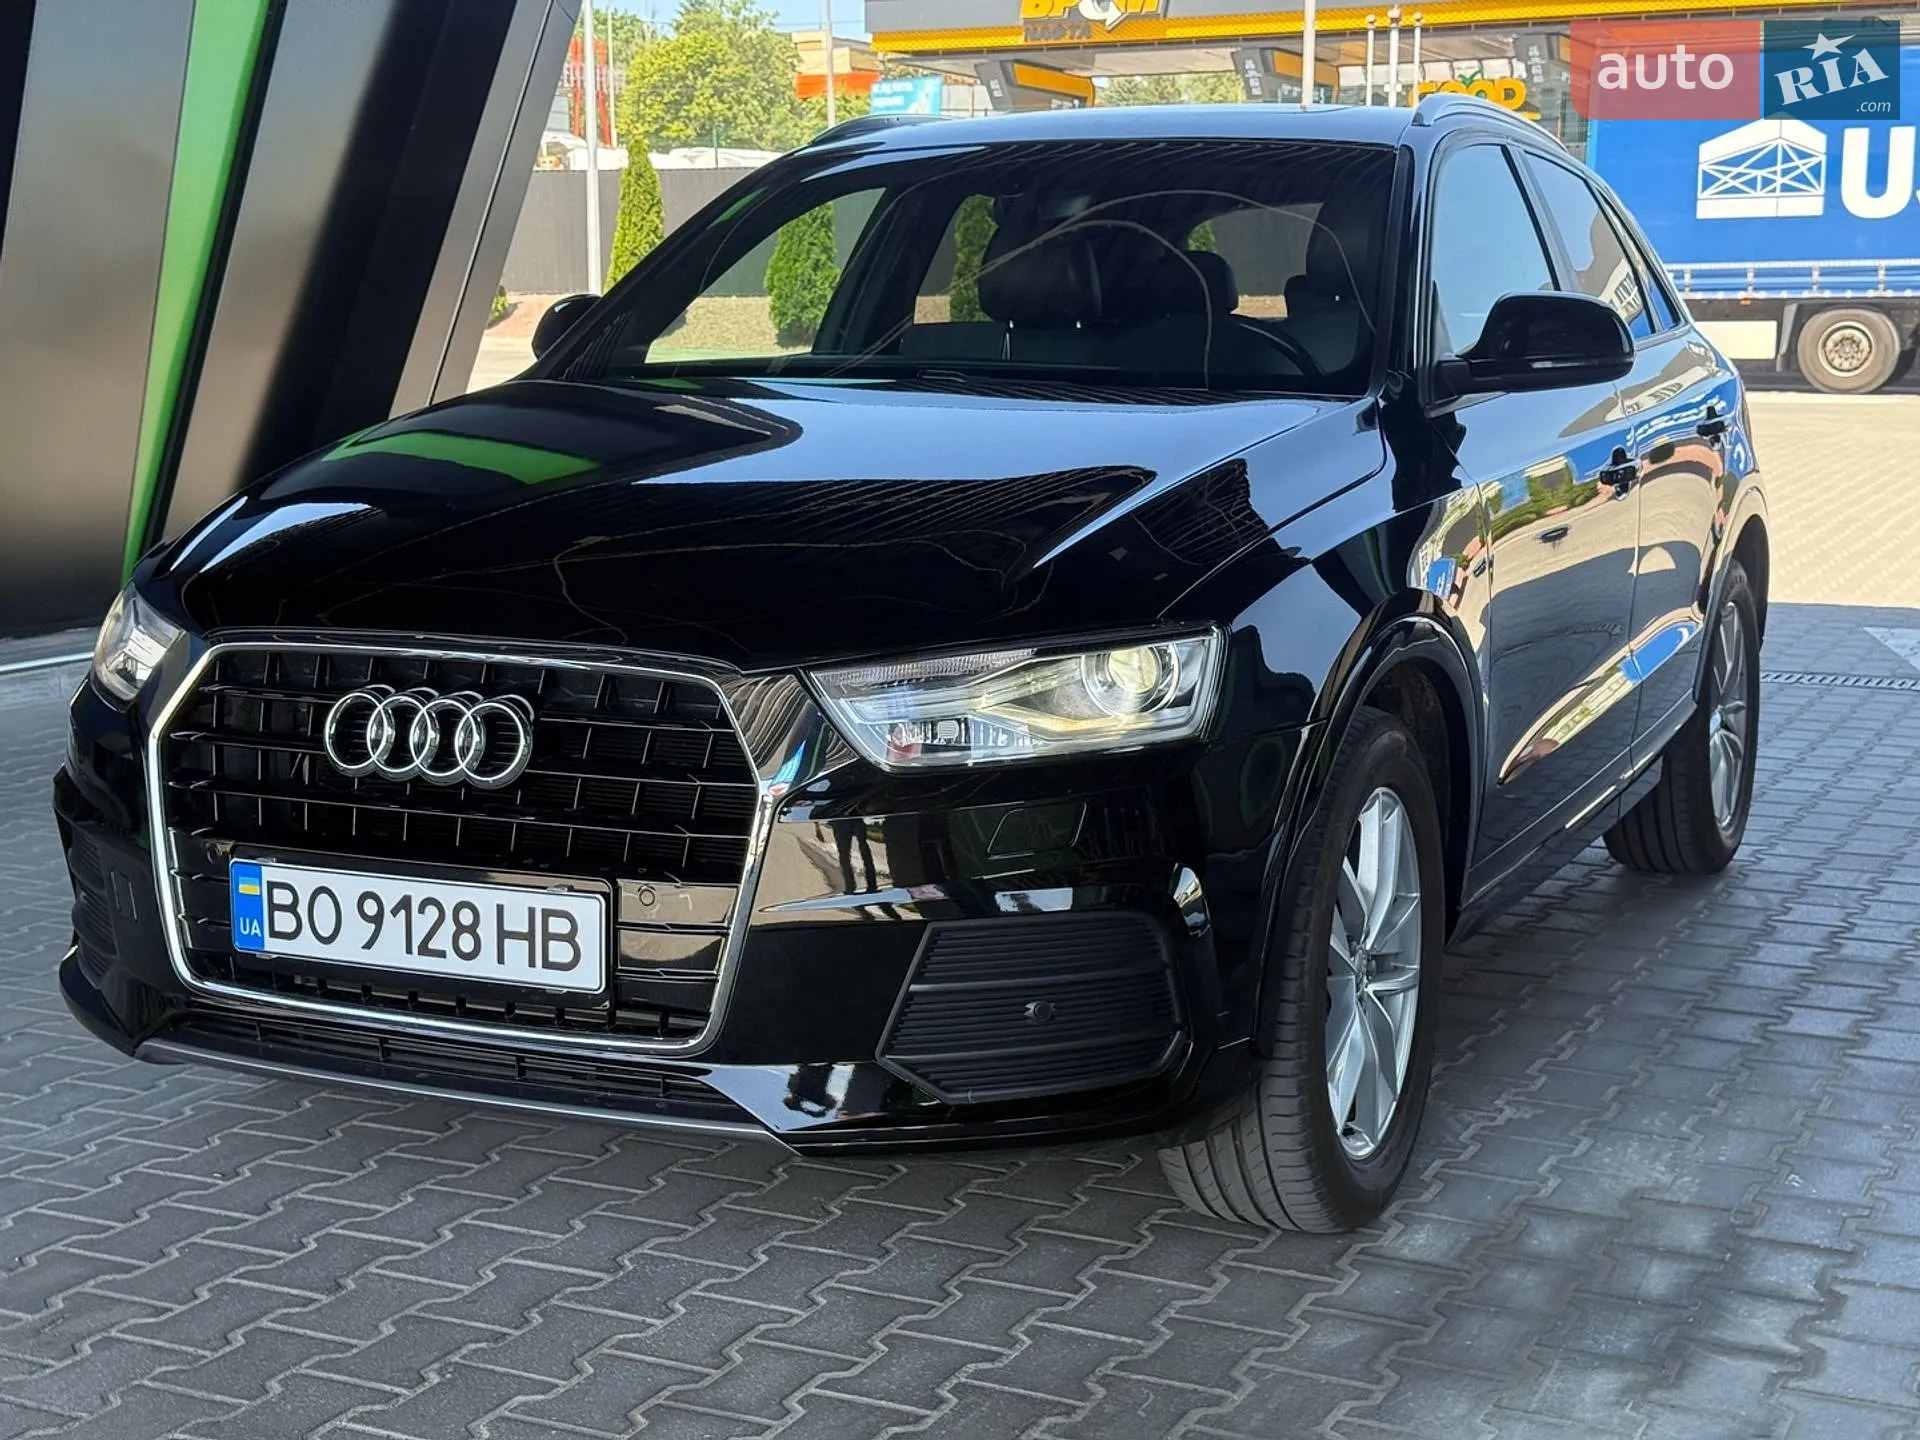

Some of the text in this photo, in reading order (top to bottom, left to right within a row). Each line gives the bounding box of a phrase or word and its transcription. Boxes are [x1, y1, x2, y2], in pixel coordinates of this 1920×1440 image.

[1841, 126, 1920, 219] U
[239, 917, 262, 937] UA
[266, 880, 582, 972] BO 9128 HB
